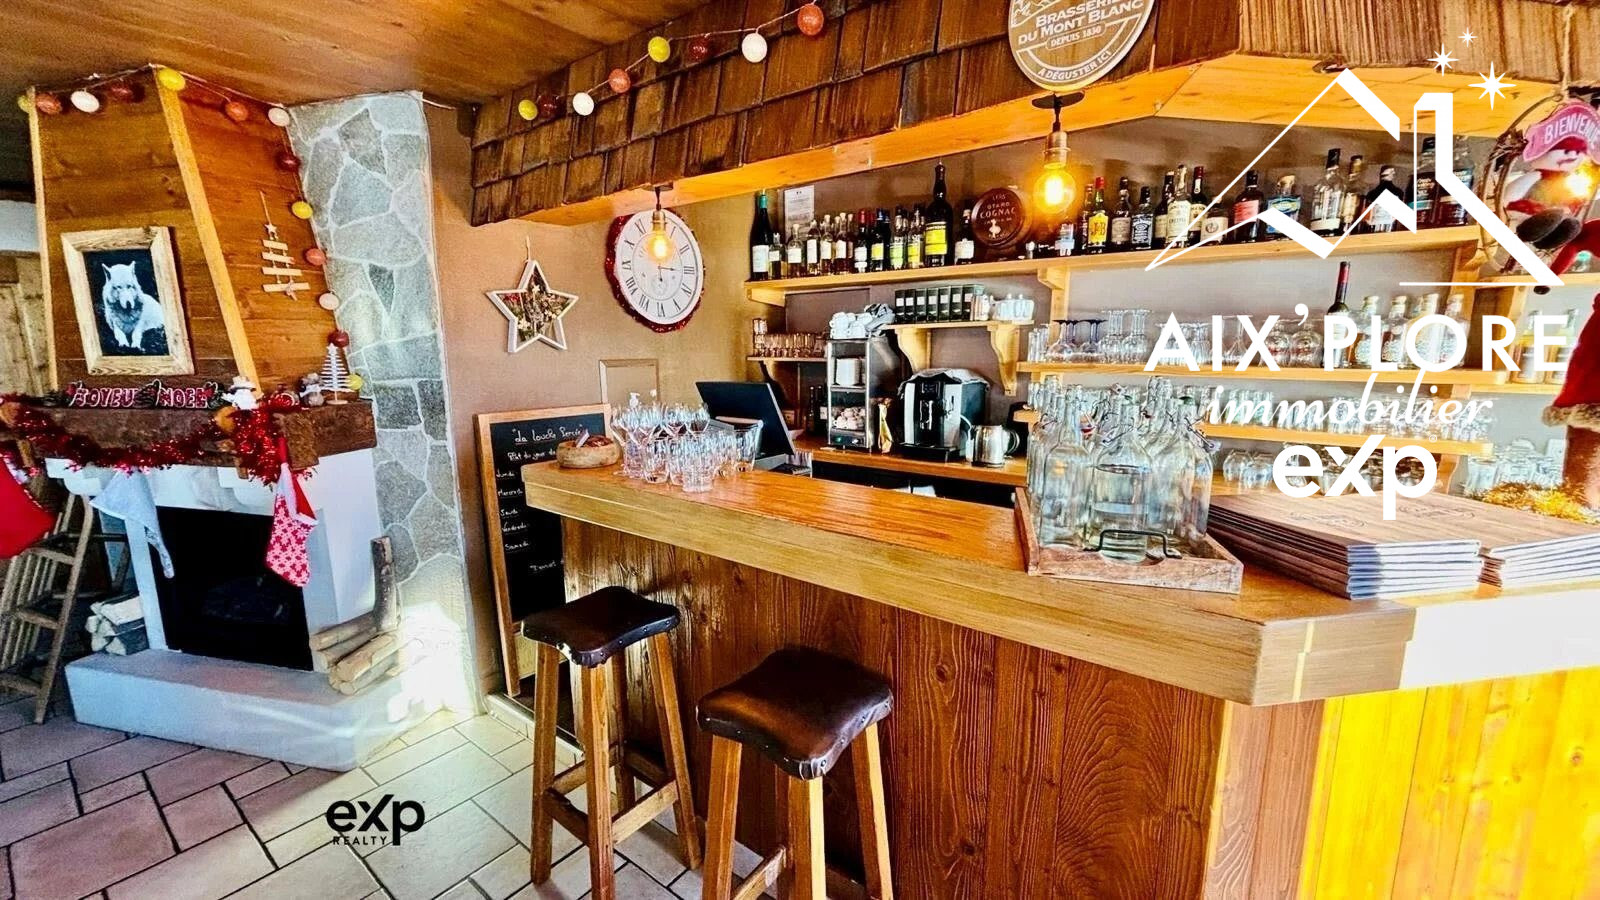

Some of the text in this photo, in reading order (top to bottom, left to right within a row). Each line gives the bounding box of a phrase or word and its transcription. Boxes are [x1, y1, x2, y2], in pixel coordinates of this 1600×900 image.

[1018, 0, 1144, 45] DU MONT BLANC
[1036, 0, 1120, 28] BRASSERI
[1050, 25, 1102, 47] DEPUIS 1830
[1097, 50, 1112, 65] ICI
[980, 206, 1016, 219] COGNAC
[75, 387, 137, 407] JOYEU
